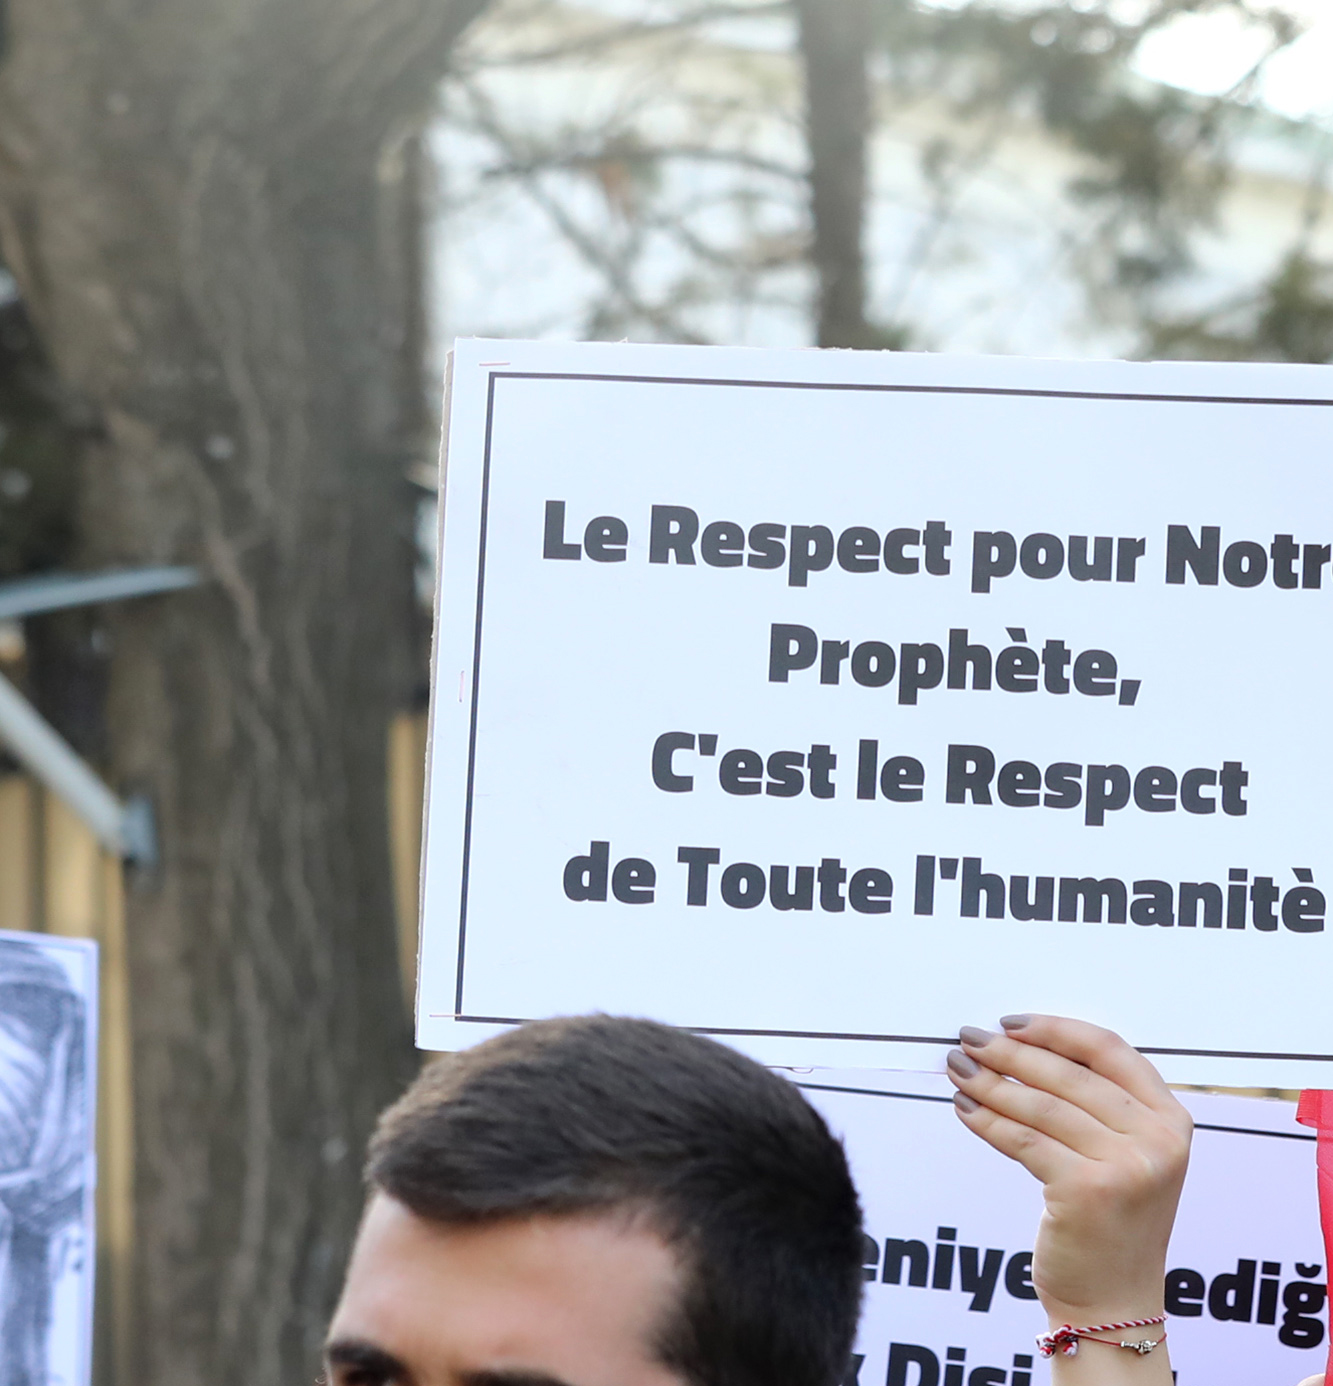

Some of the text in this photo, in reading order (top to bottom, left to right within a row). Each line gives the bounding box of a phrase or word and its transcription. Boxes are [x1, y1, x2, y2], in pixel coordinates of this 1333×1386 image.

[543, 500, 629, 563] Le
[649, 504, 952, 587] Respect
[971, 527, 1146, 594] pour
[768, 623, 1142, 706] Prophète,
[651, 731, 1249, 827] C'est le Respect
[563, 840, 1326, 933] de Toute l'humanitè
[1163, 1258, 1329, 1349] ediğ
